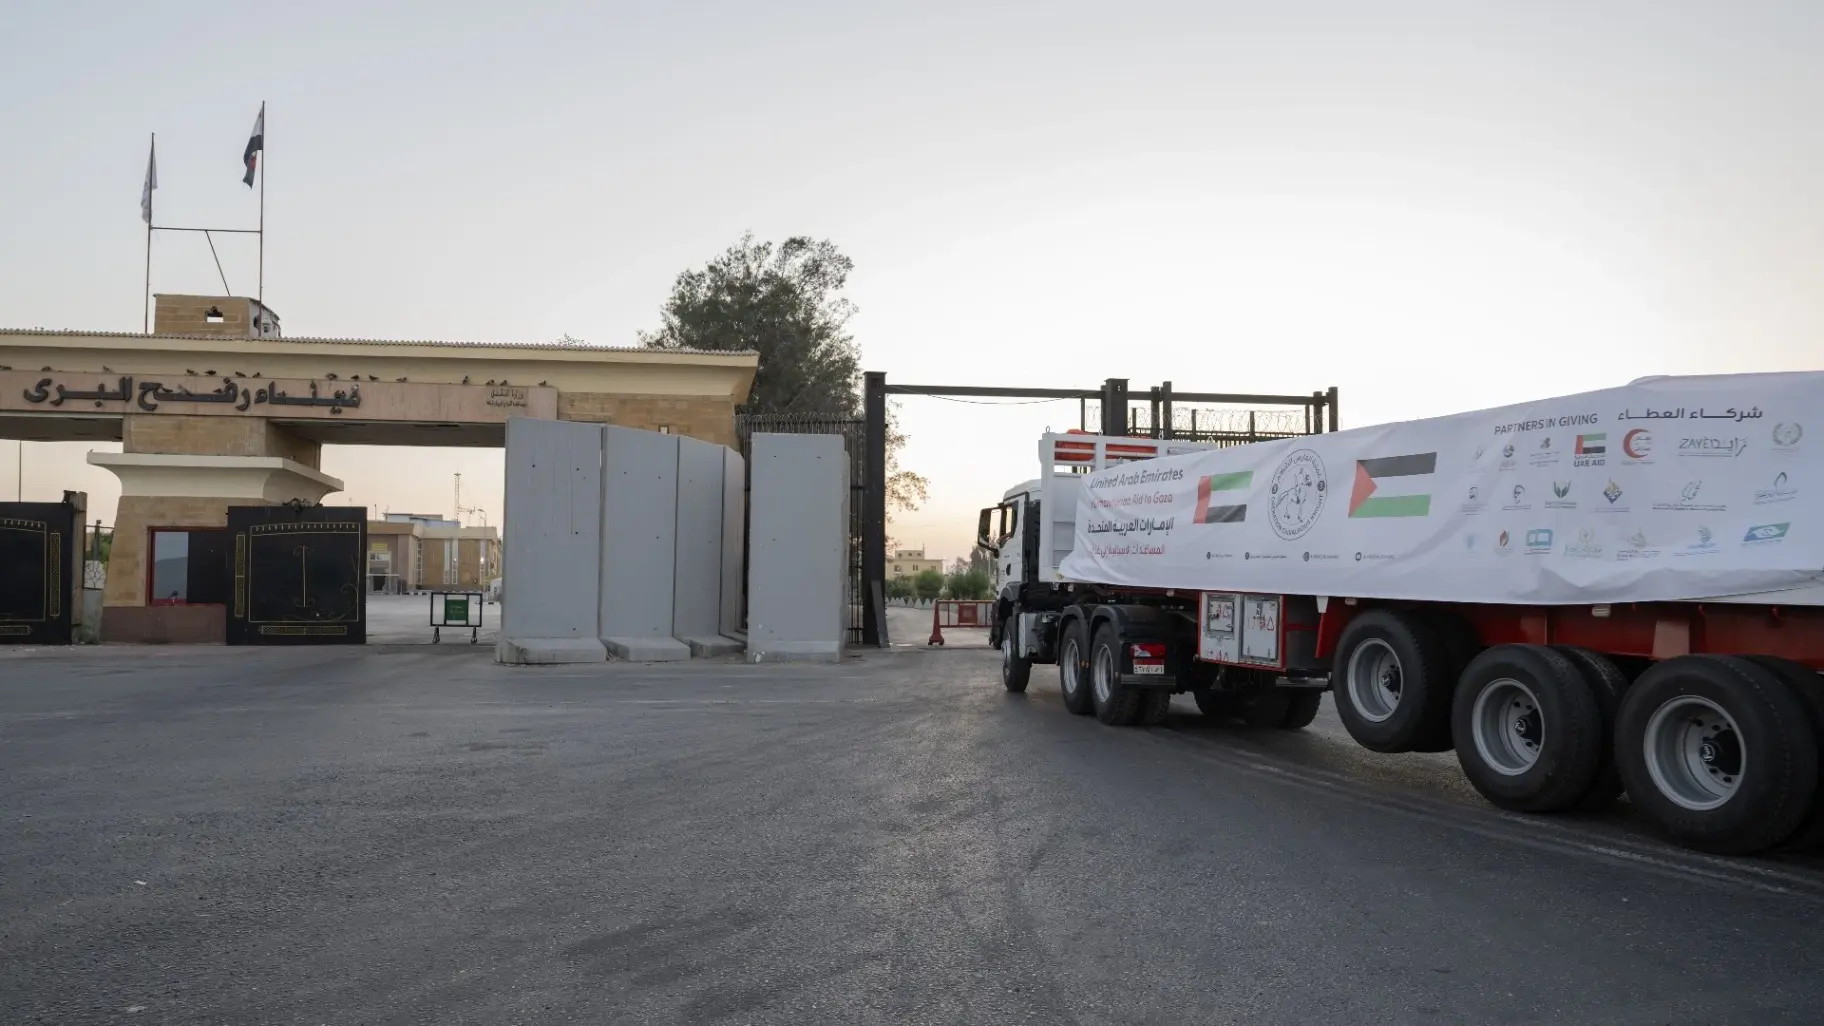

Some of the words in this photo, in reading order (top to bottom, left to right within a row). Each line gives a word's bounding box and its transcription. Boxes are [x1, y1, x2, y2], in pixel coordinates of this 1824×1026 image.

[137, 377, 250, 411] رفح
[1617, 406, 1685, 421] العطاء
[1689, 407, 1764, 422] شركاء
[1494, 419, 1545, 435] PARTNERS
[1546, 417, 1557, 429] IN
[1559, 413, 1598, 427] GIVING
[1678, 437, 1720, 449] ZAYED
[1573, 459, 1590, 467] UAE
[1591, 458, 1605, 466] AID
[1090, 473, 1119, 489] United
[1118, 471, 1139, 487] Arab
[1140, 468, 1184, 484] Emirates
[1132, 492, 1143, 505] Aid
[1144, 494, 1152, 505] to
[1152, 491, 1173, 506] Gaza
[1087, 519, 1113, 534] المتحدة
[1139, 515, 1175, 536] الإمارات
